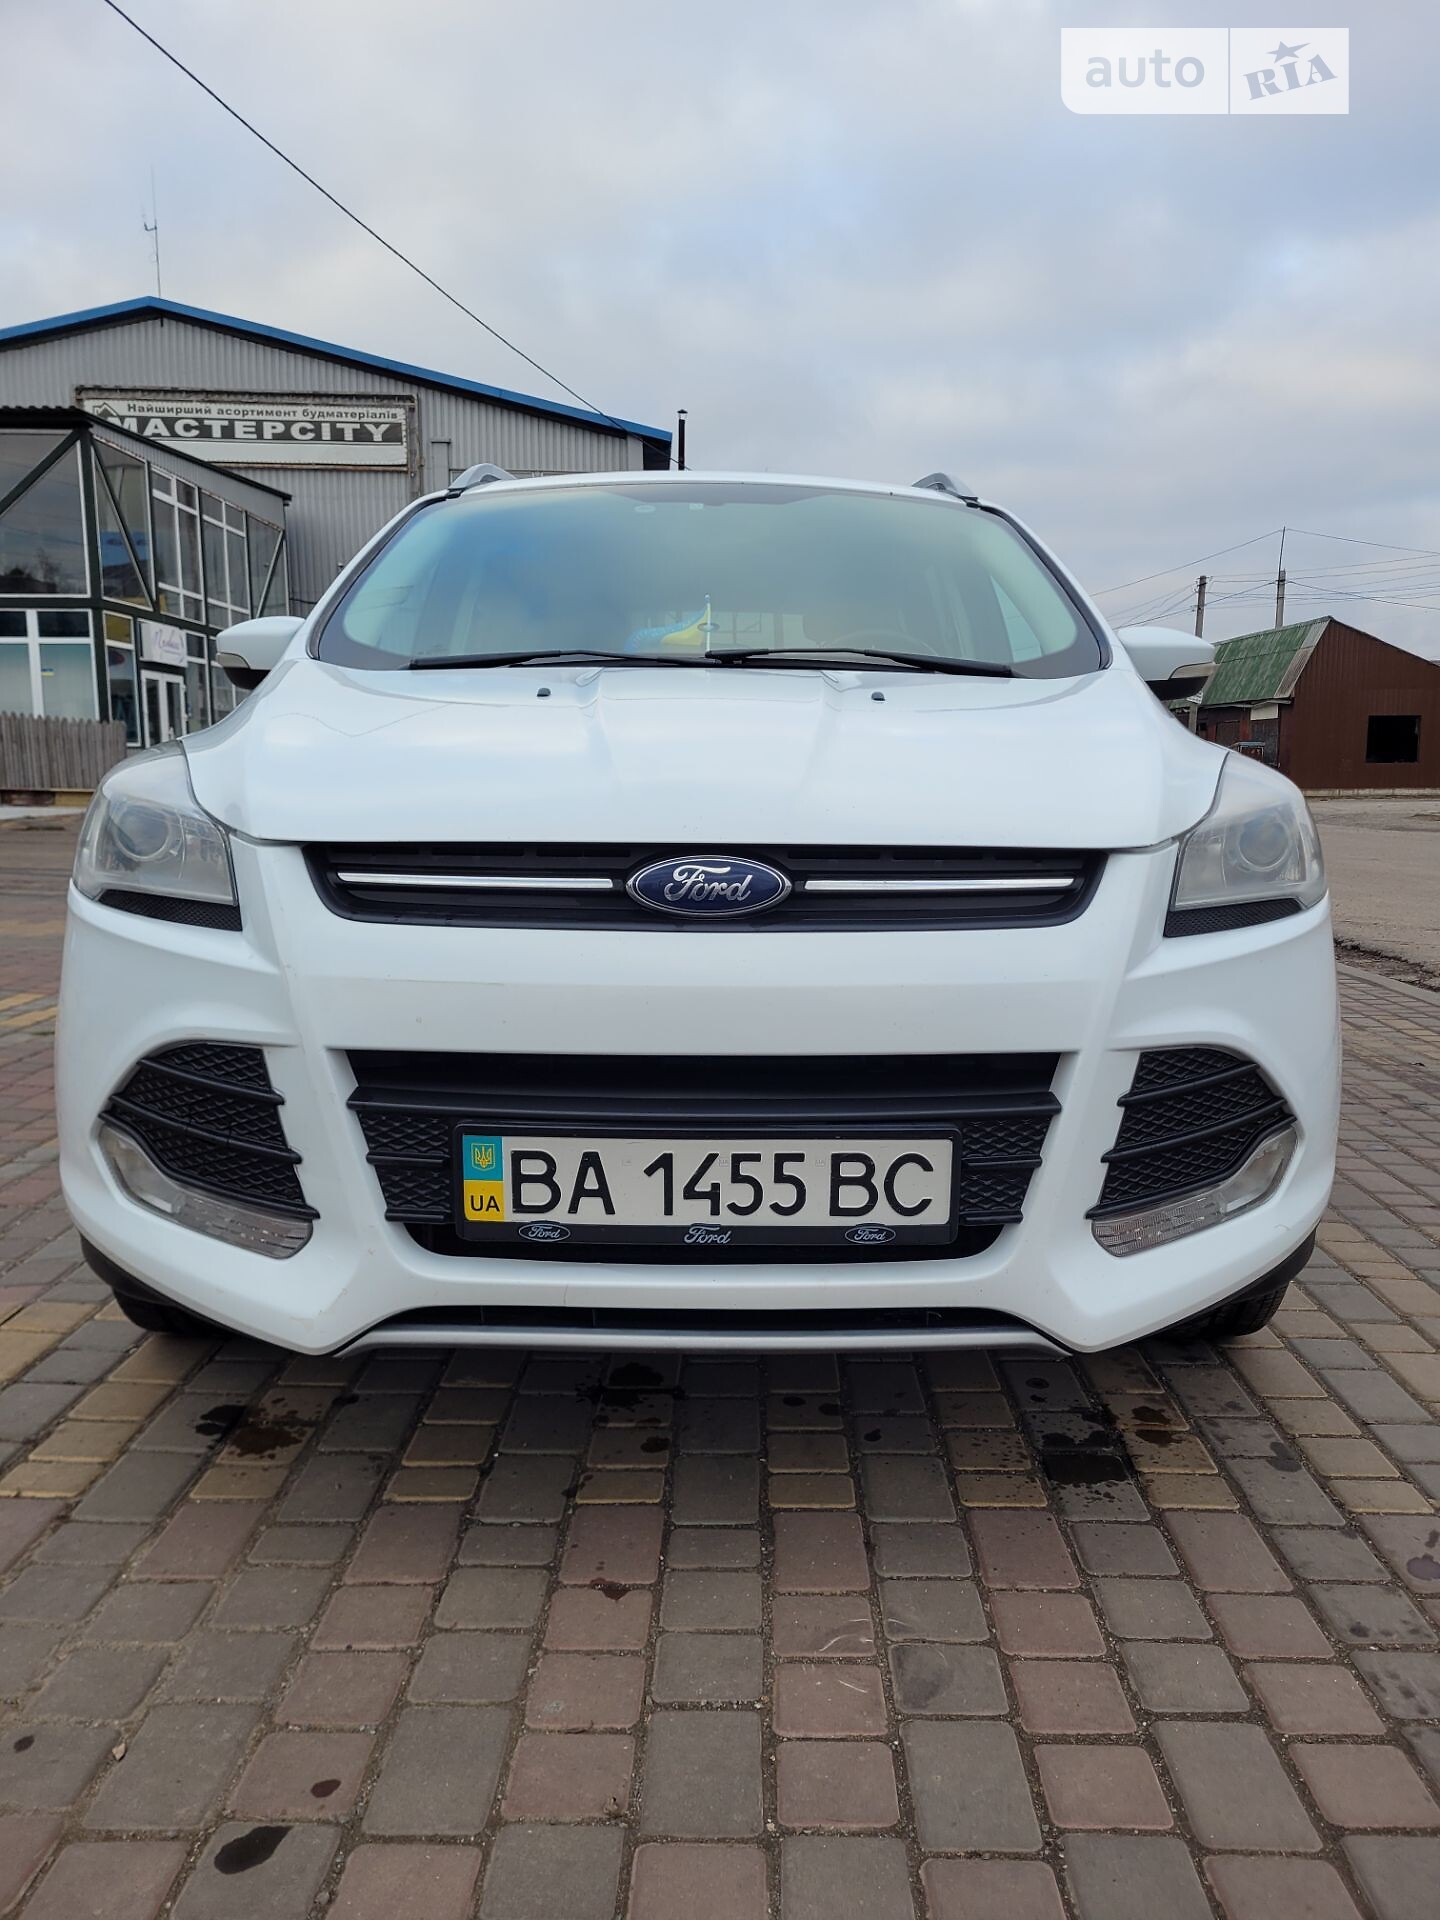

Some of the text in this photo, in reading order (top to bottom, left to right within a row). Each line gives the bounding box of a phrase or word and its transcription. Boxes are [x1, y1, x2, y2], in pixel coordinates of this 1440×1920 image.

[127, 403, 398, 420] Найширший асортимент будматеріалів
[664, 864, 753, 902] Ford
[510, 1150, 934, 1217] BA 1455 BC
[470, 1195, 500, 1212] UA
[528, 1224, 561, 1239] Ford
[684, 1226, 731, 1245] Ford
[854, 1227, 887, 1242] Ford
